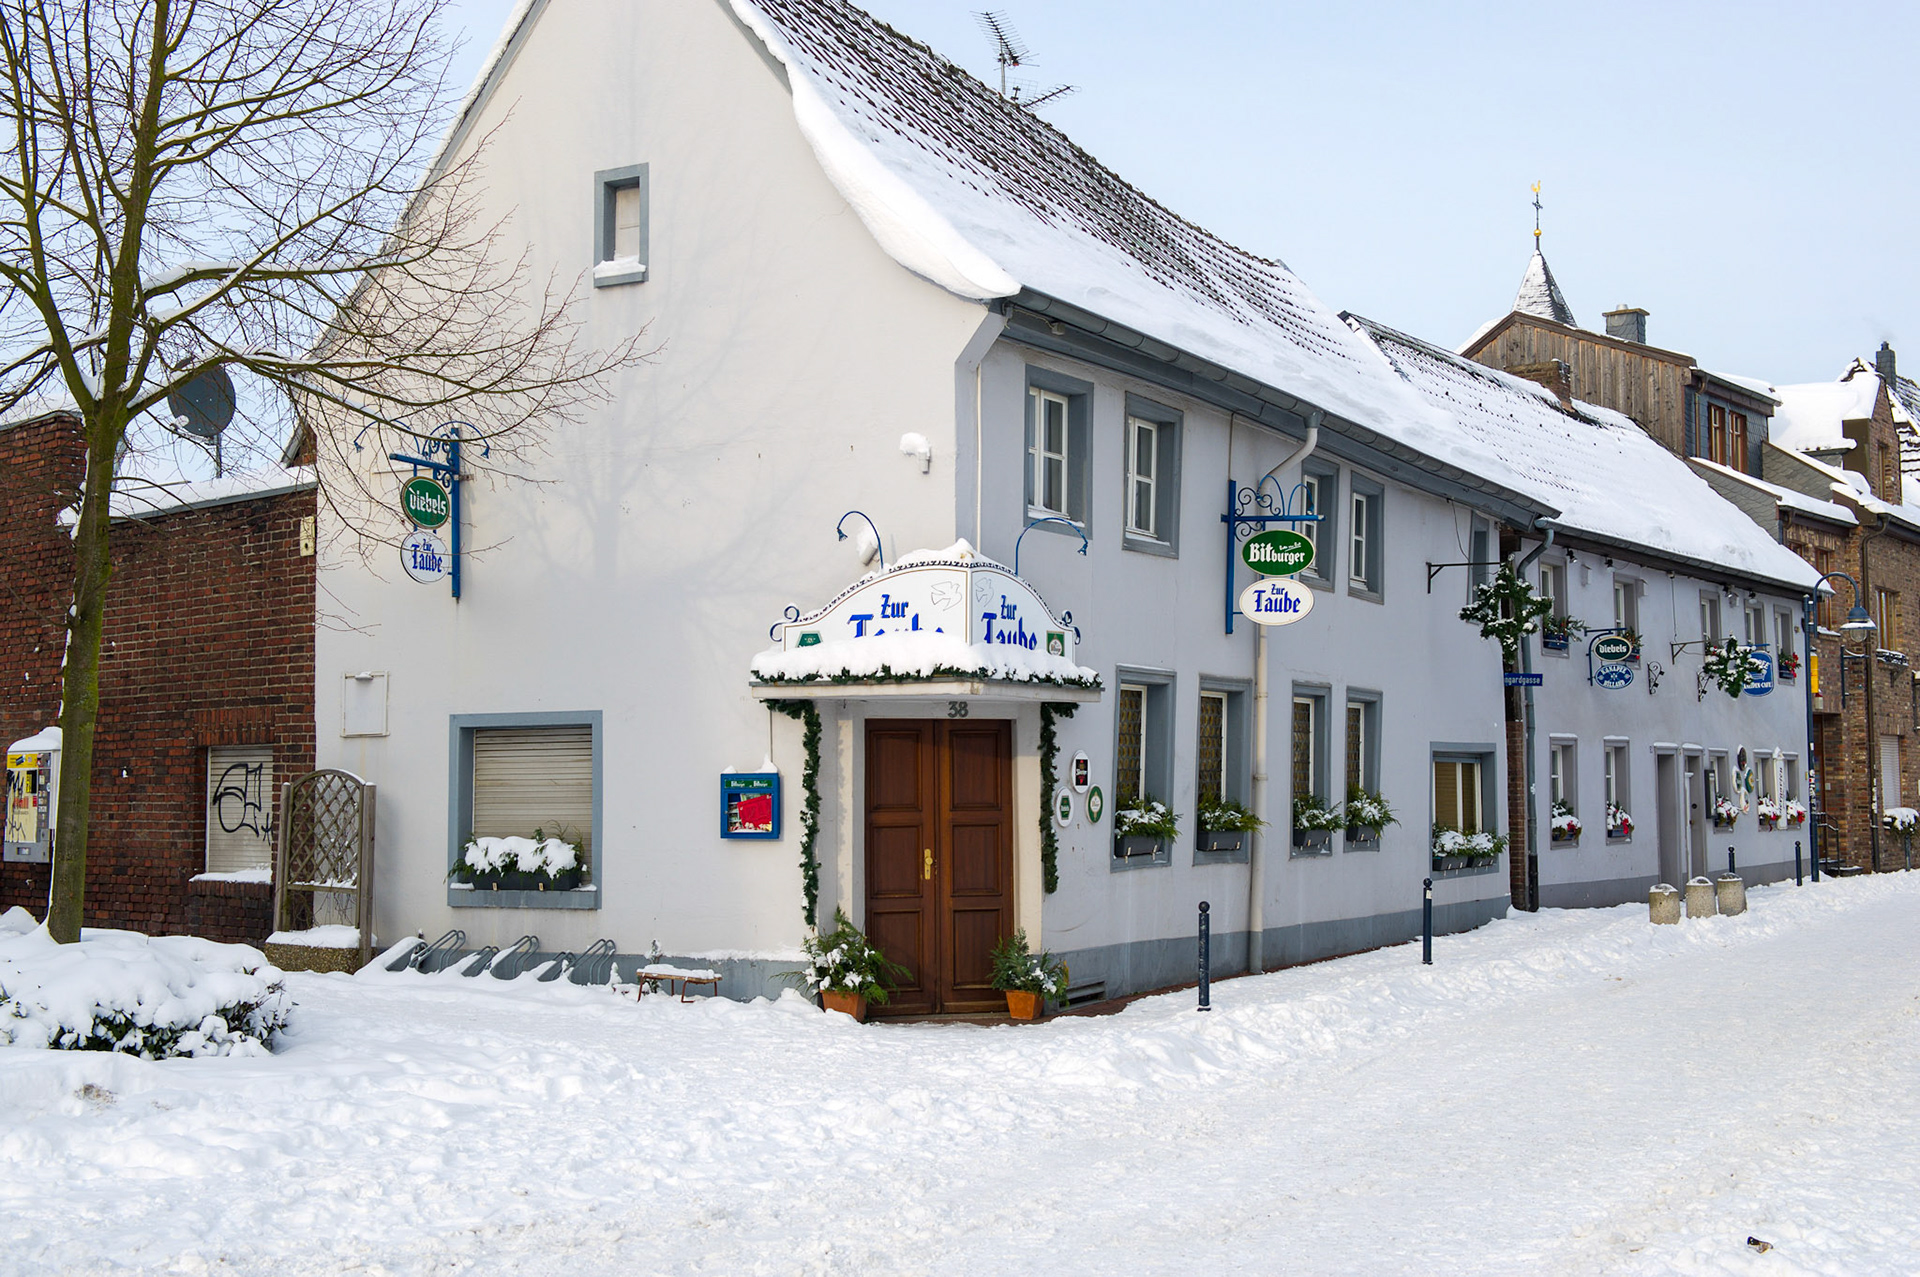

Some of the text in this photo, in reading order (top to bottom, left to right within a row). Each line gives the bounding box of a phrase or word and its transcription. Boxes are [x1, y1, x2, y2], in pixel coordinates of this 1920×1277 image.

[411, 544, 443, 573] Taube
[1248, 542, 1306, 565] Bitburger
[1271, 583, 1285, 595] Zur
[880, 593, 909, 619] Zur
[1000, 594, 1017, 620] Zur
[1253, 590, 1301, 613] Taube
[1598, 643, 1628, 654] Diebels
[947, 700, 969, 718] 38
